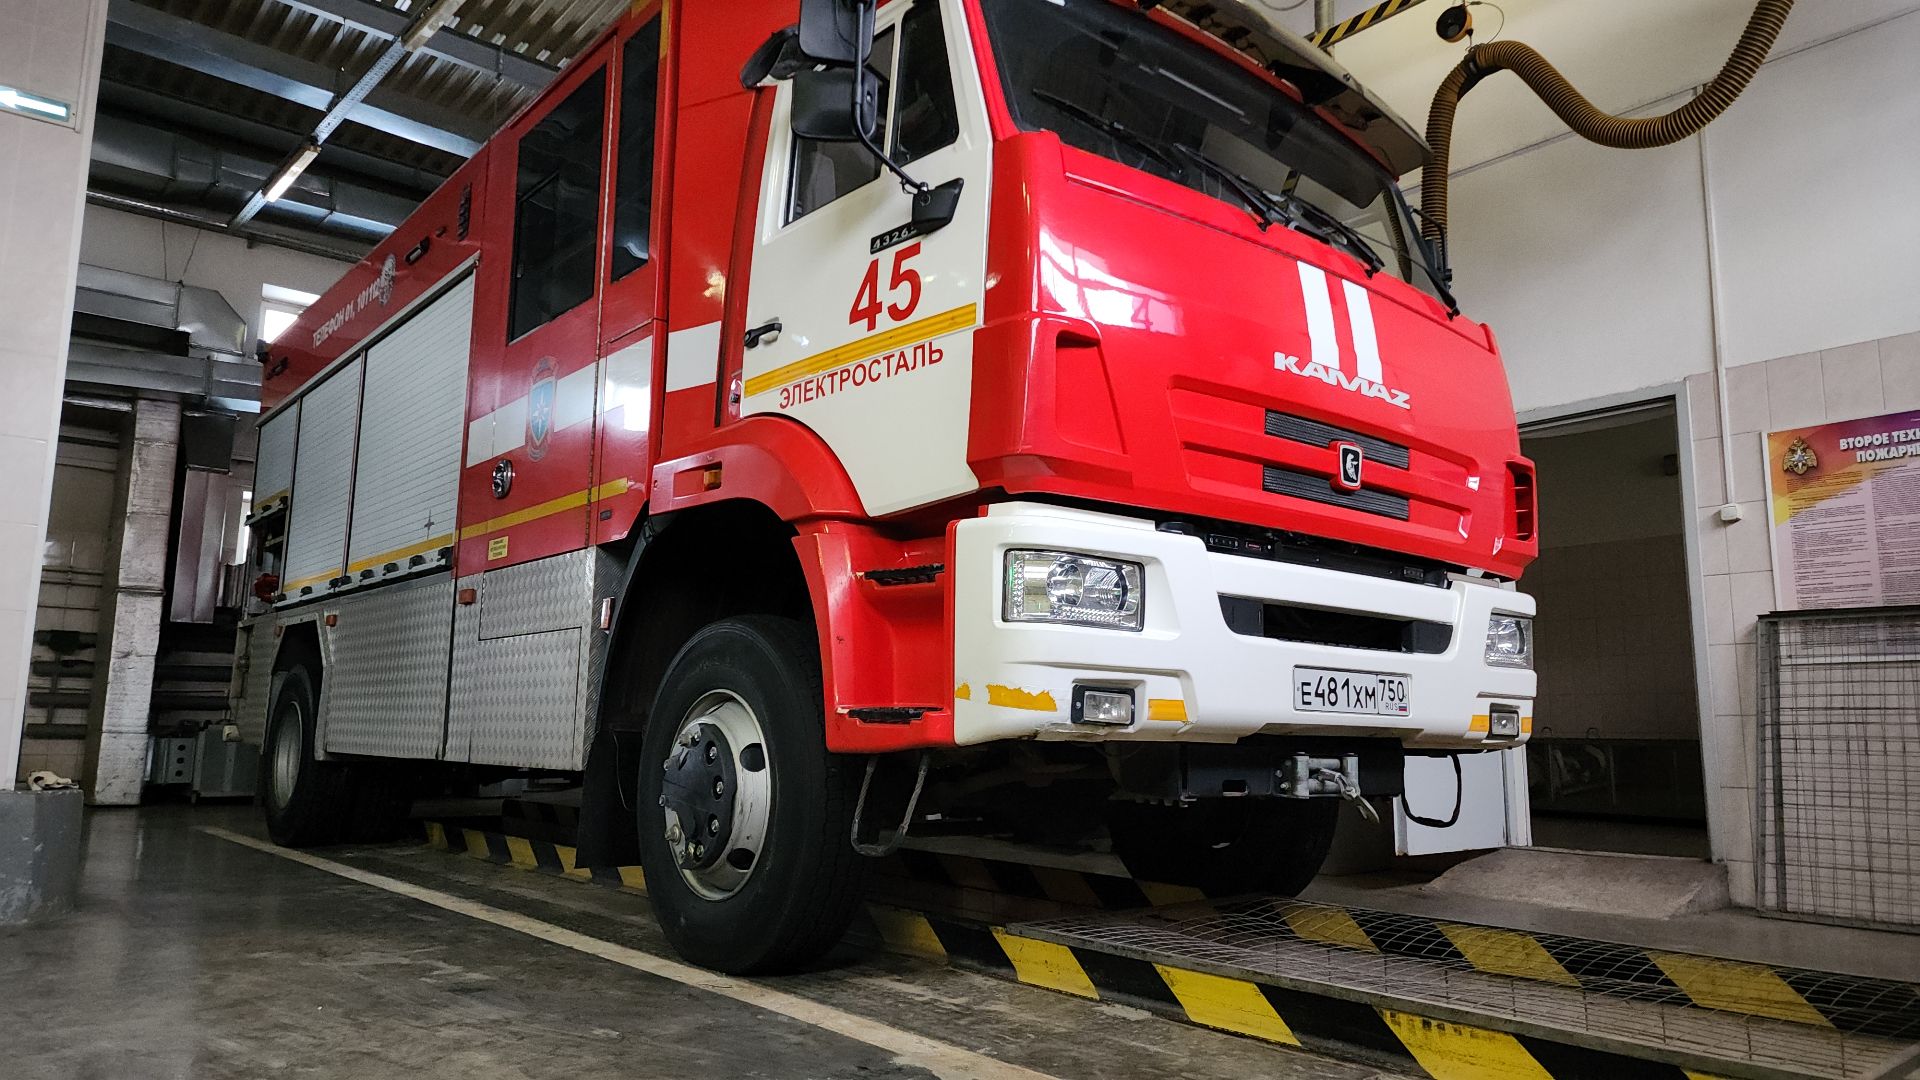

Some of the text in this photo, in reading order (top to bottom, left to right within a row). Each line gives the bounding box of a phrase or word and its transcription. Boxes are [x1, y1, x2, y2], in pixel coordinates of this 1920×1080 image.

[849, 241, 922, 332] 45
[313, 308, 345, 349] ТЕЛЕФОН
[779, 341, 944, 410] ЭЛЕКТРОСТАЛЬ
[1273, 351, 1411, 410] KAMAZ
[1840, 432, 1889, 451] ВТОРОЕ
[1379, 679, 1405, 702] 750
[1385, 702, 1398, 711] RUS
